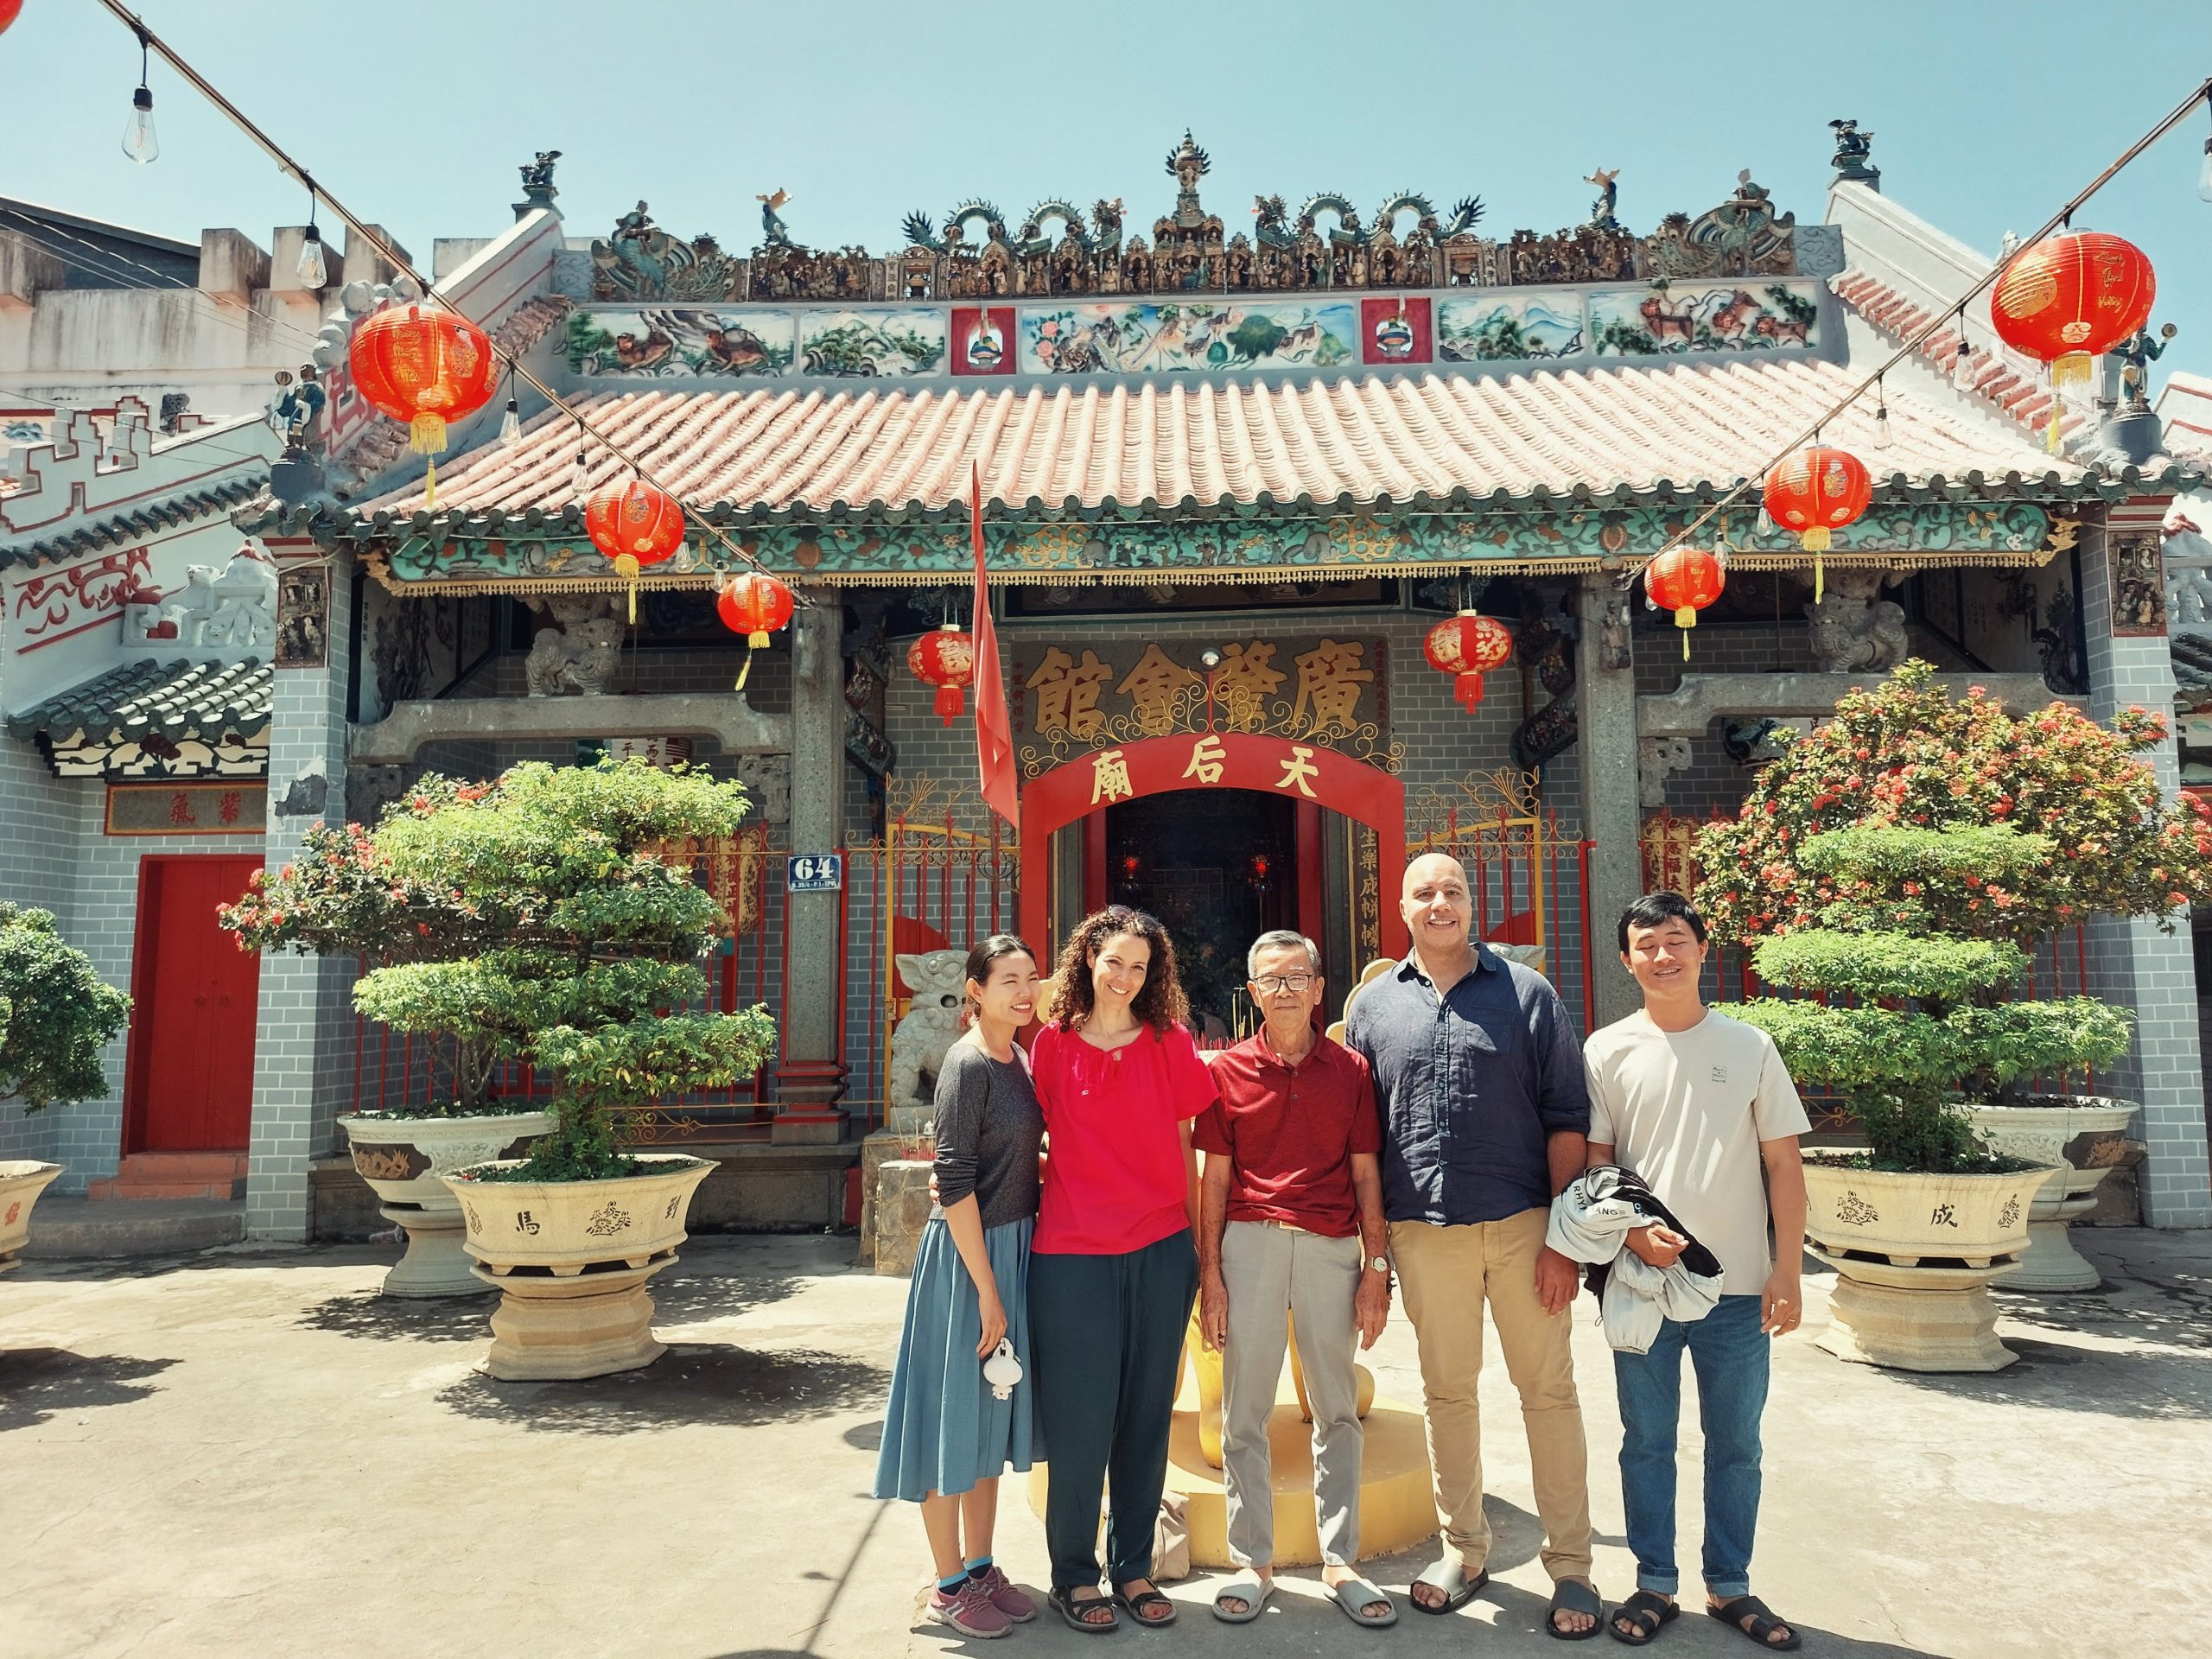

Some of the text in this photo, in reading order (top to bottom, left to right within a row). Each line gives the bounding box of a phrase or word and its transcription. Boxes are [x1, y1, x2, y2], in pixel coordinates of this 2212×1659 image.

[1091, 734, 1319, 805] 天后廟
[795, 857, 835, 880] 64
[516, 1211, 540, 1236] 馬
[1929, 1203, 1958, 1228] 成
